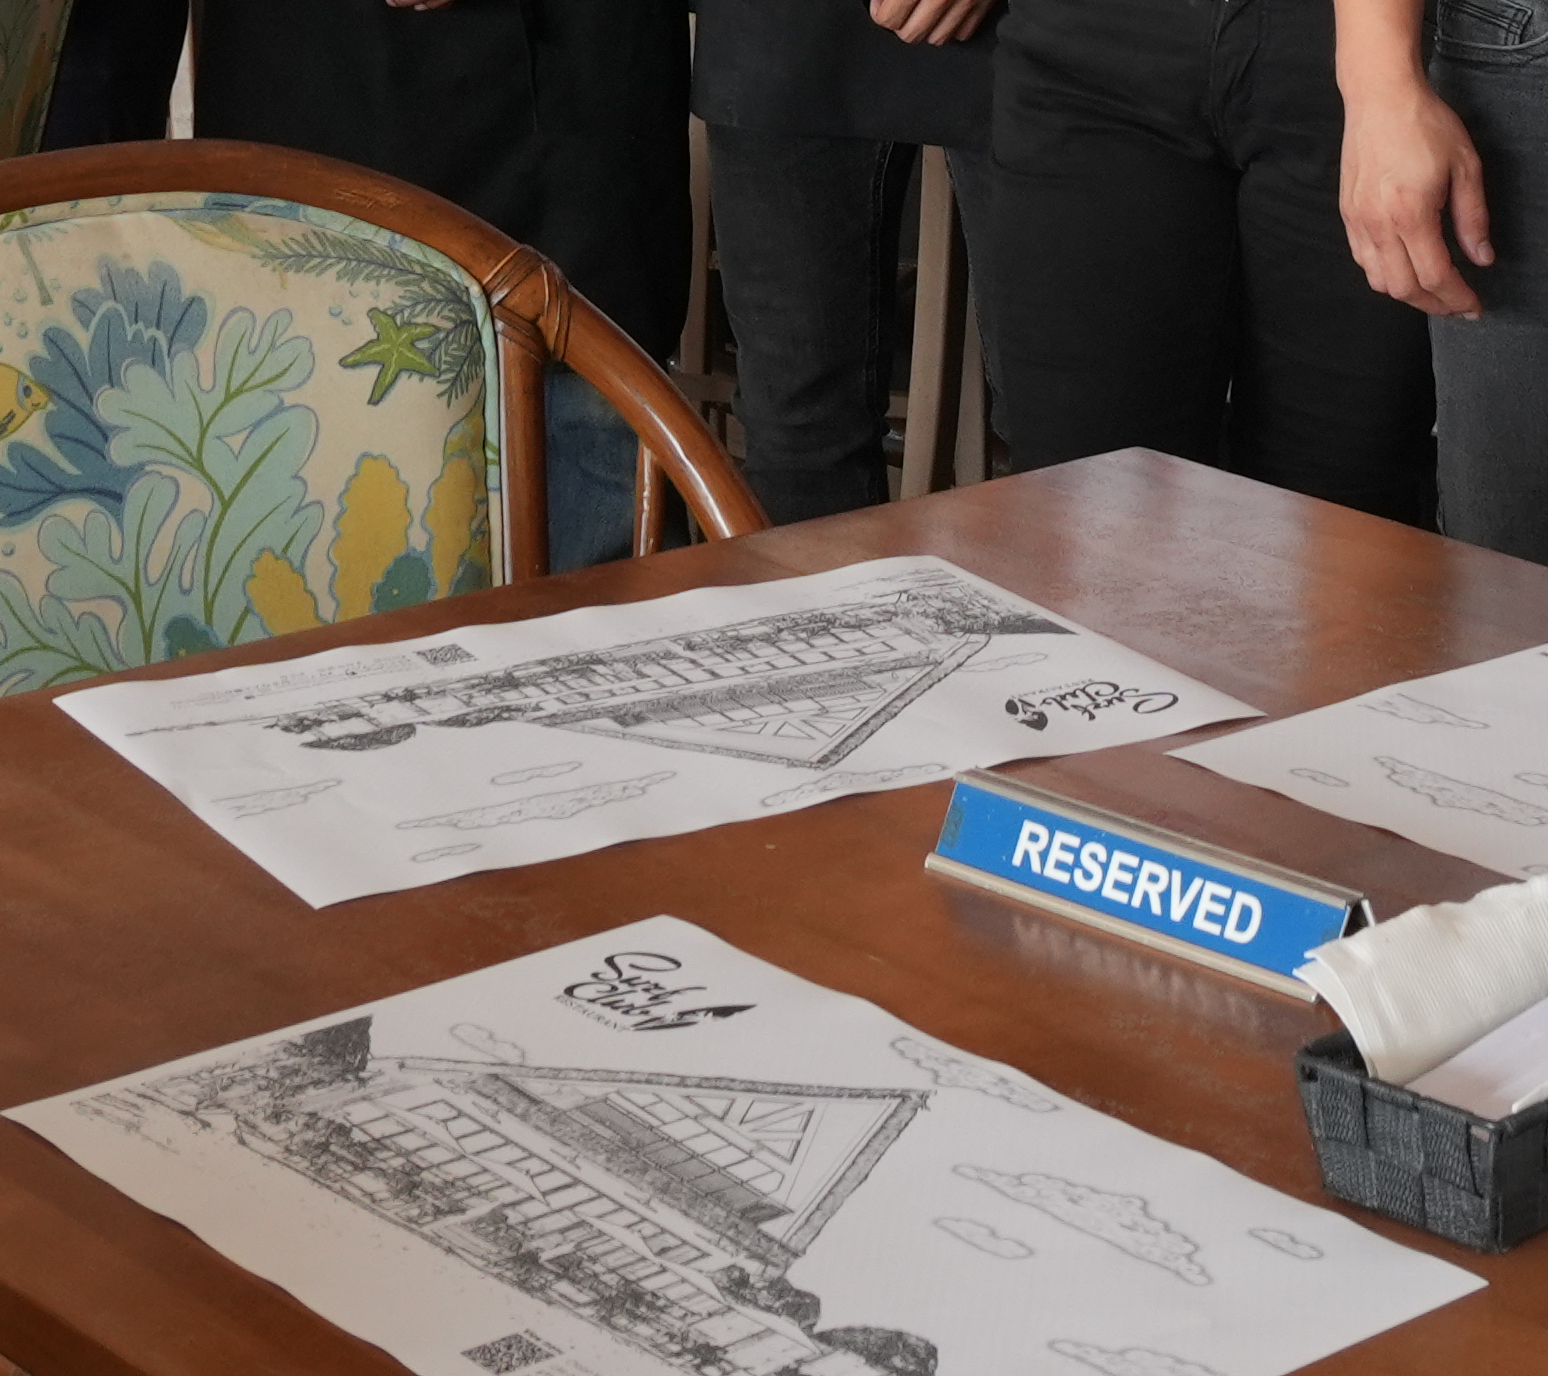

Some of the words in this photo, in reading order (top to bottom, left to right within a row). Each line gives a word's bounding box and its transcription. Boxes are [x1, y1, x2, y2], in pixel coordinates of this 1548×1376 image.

[1012, 818, 1263, 945] RESERVED
[563, 980, 673, 1017] Club
[590, 951, 708, 1003] Surf
